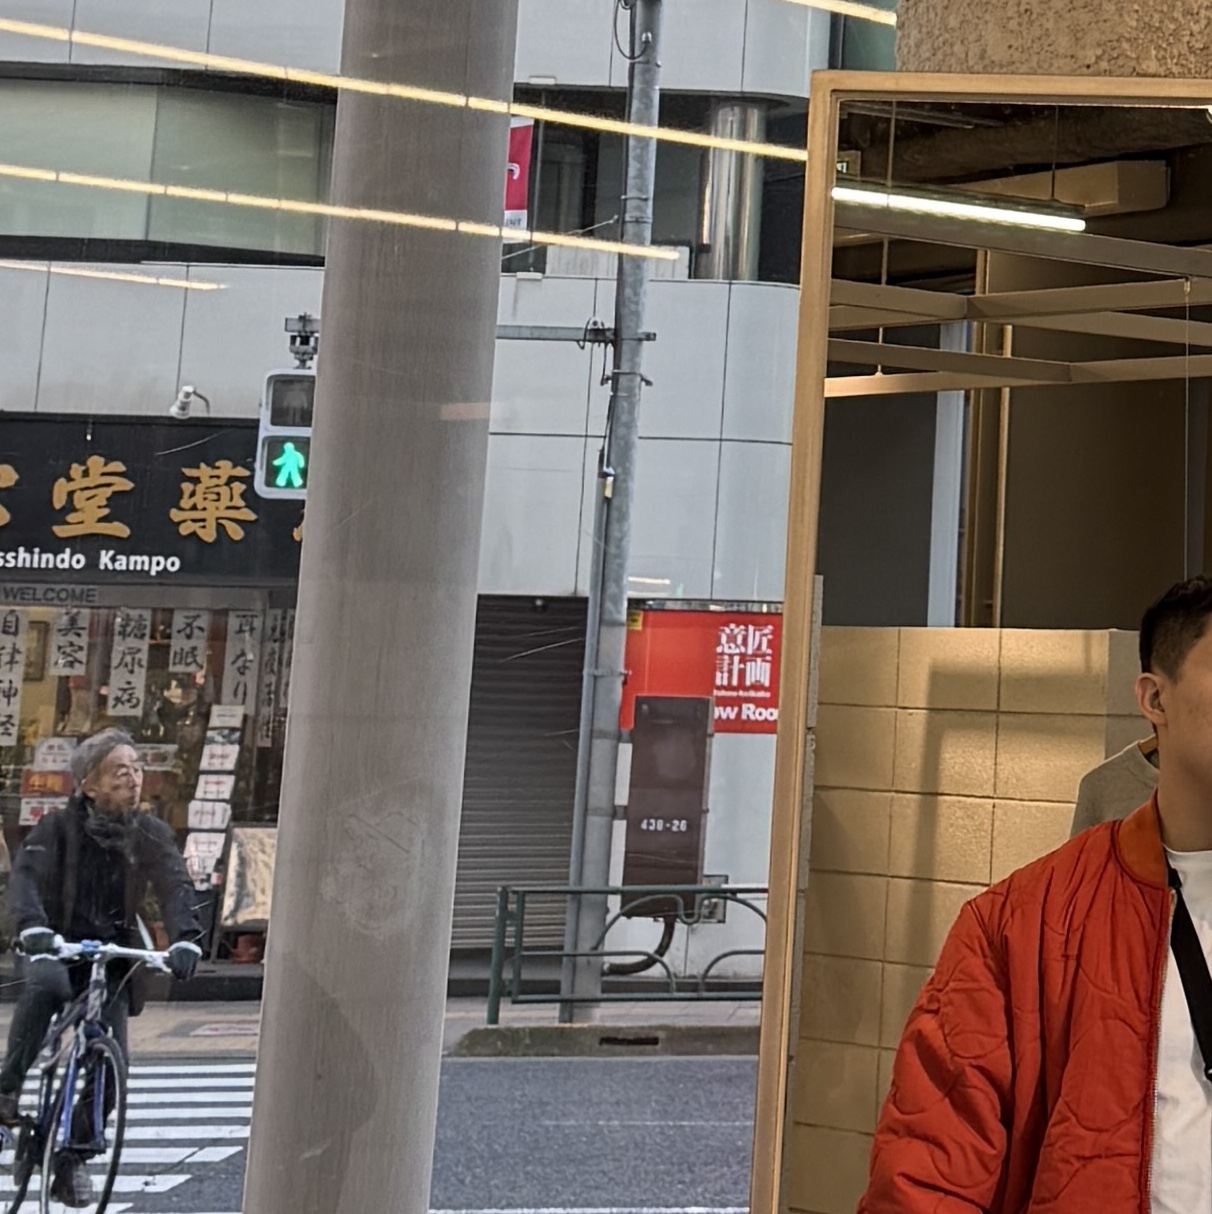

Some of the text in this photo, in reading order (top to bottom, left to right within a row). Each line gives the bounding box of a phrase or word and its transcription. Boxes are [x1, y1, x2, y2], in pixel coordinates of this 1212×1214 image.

[99, 549, 181, 576] Kampo
[3, 586, 97, 603] WELCOME
[172, 614, 205, 669] 不眠
[112, 613, 147, 709] 糖尿病
[741, 703, 779, 721] Roo
